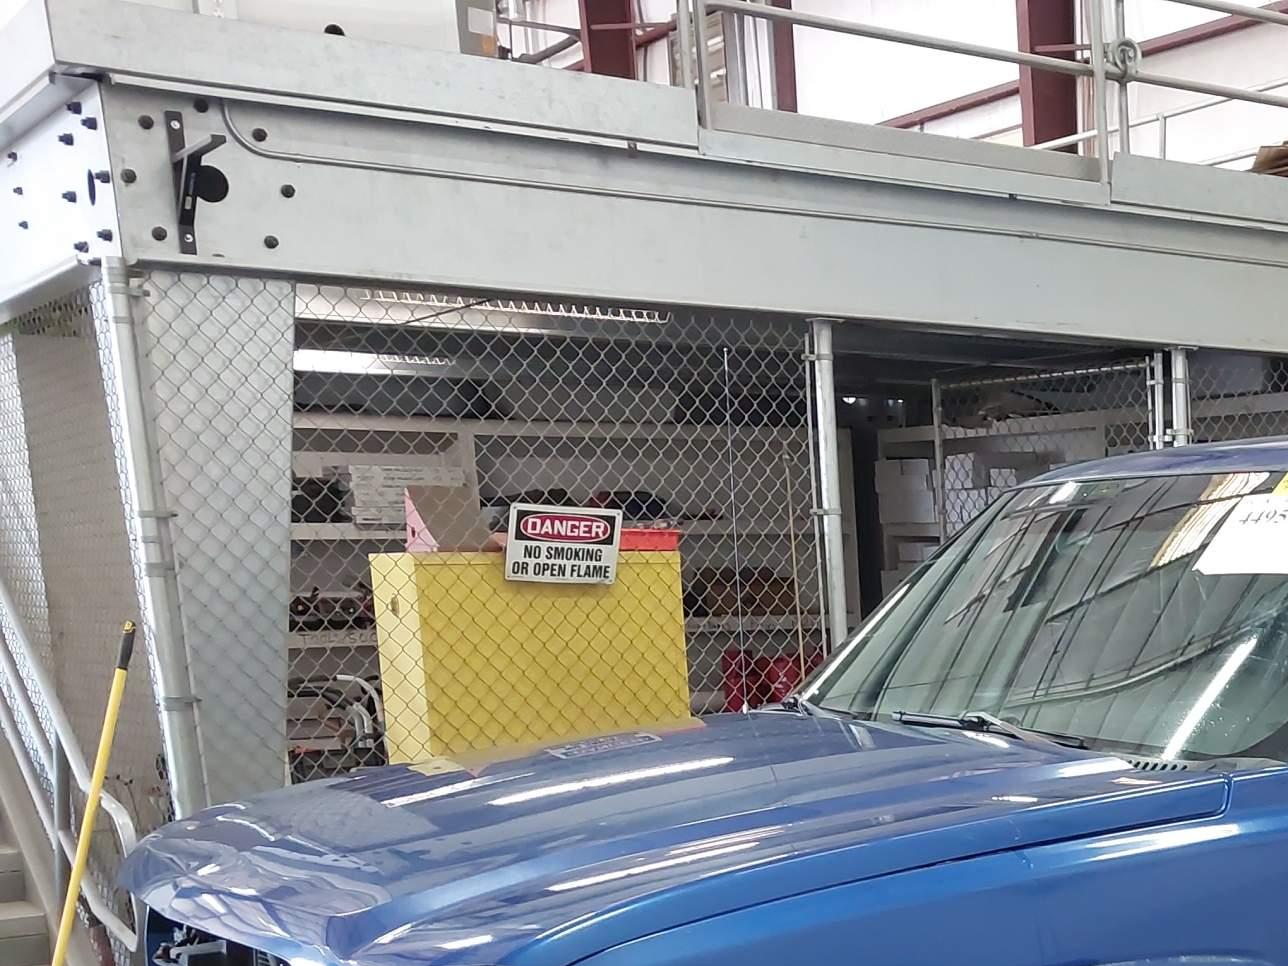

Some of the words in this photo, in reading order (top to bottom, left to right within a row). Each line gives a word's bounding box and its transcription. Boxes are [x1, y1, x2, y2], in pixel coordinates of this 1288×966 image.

[527, 518, 605, 538] DANGER
[523, 545, 542, 559] NO
[545, 547, 603, 562] SMOKING
[512, 562, 529, 575] OR
[533, 563, 567, 577] OPEN
[570, 564, 611, 579] FLAME
